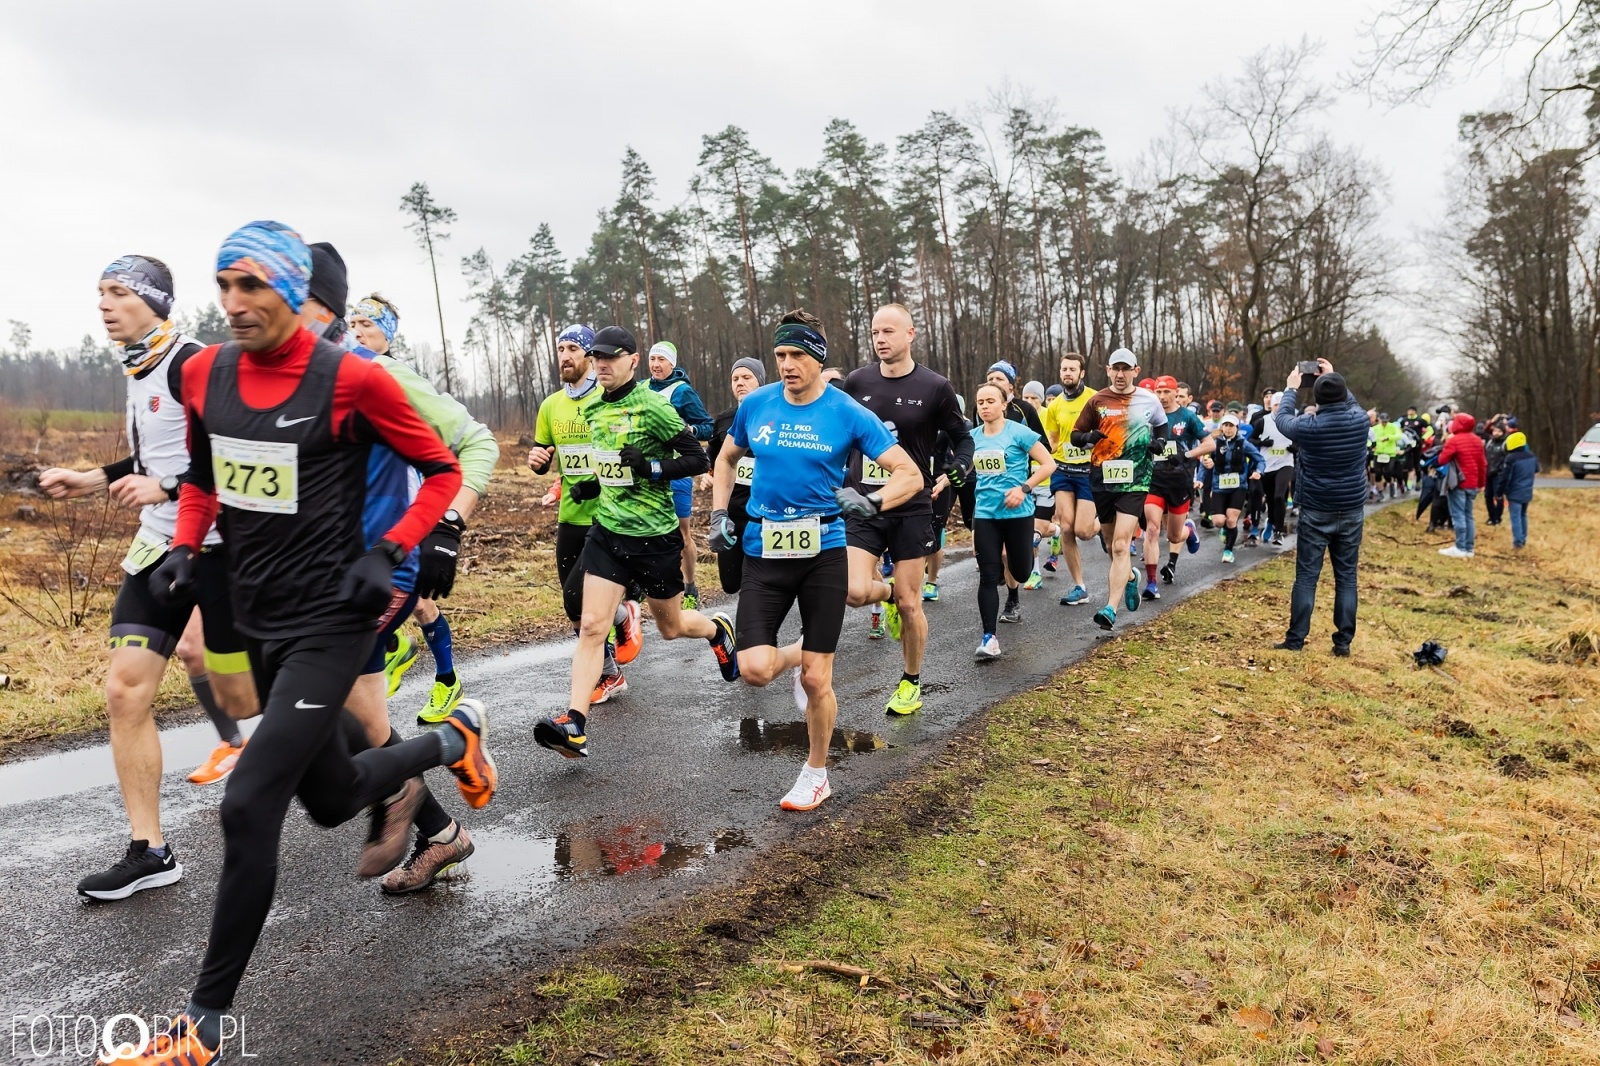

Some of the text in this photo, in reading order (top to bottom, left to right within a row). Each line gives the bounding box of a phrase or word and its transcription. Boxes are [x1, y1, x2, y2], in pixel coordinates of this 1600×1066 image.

[780, 423, 812, 432] 12. PKO
[778, 431, 819, 442] BYTOMSKI
[777, 439, 833, 453] PÓŁMARATON
[564, 454, 590, 470] 221
[978, 458, 1001, 470] 168
[598, 462, 625, 479] 223
[868, 463, 892, 479] 21
[1107, 468, 1129, 479] 175
[224, 461, 280, 497] 273
[1223, 478, 1237, 486] 173
[771, 530, 811, 550] 218
